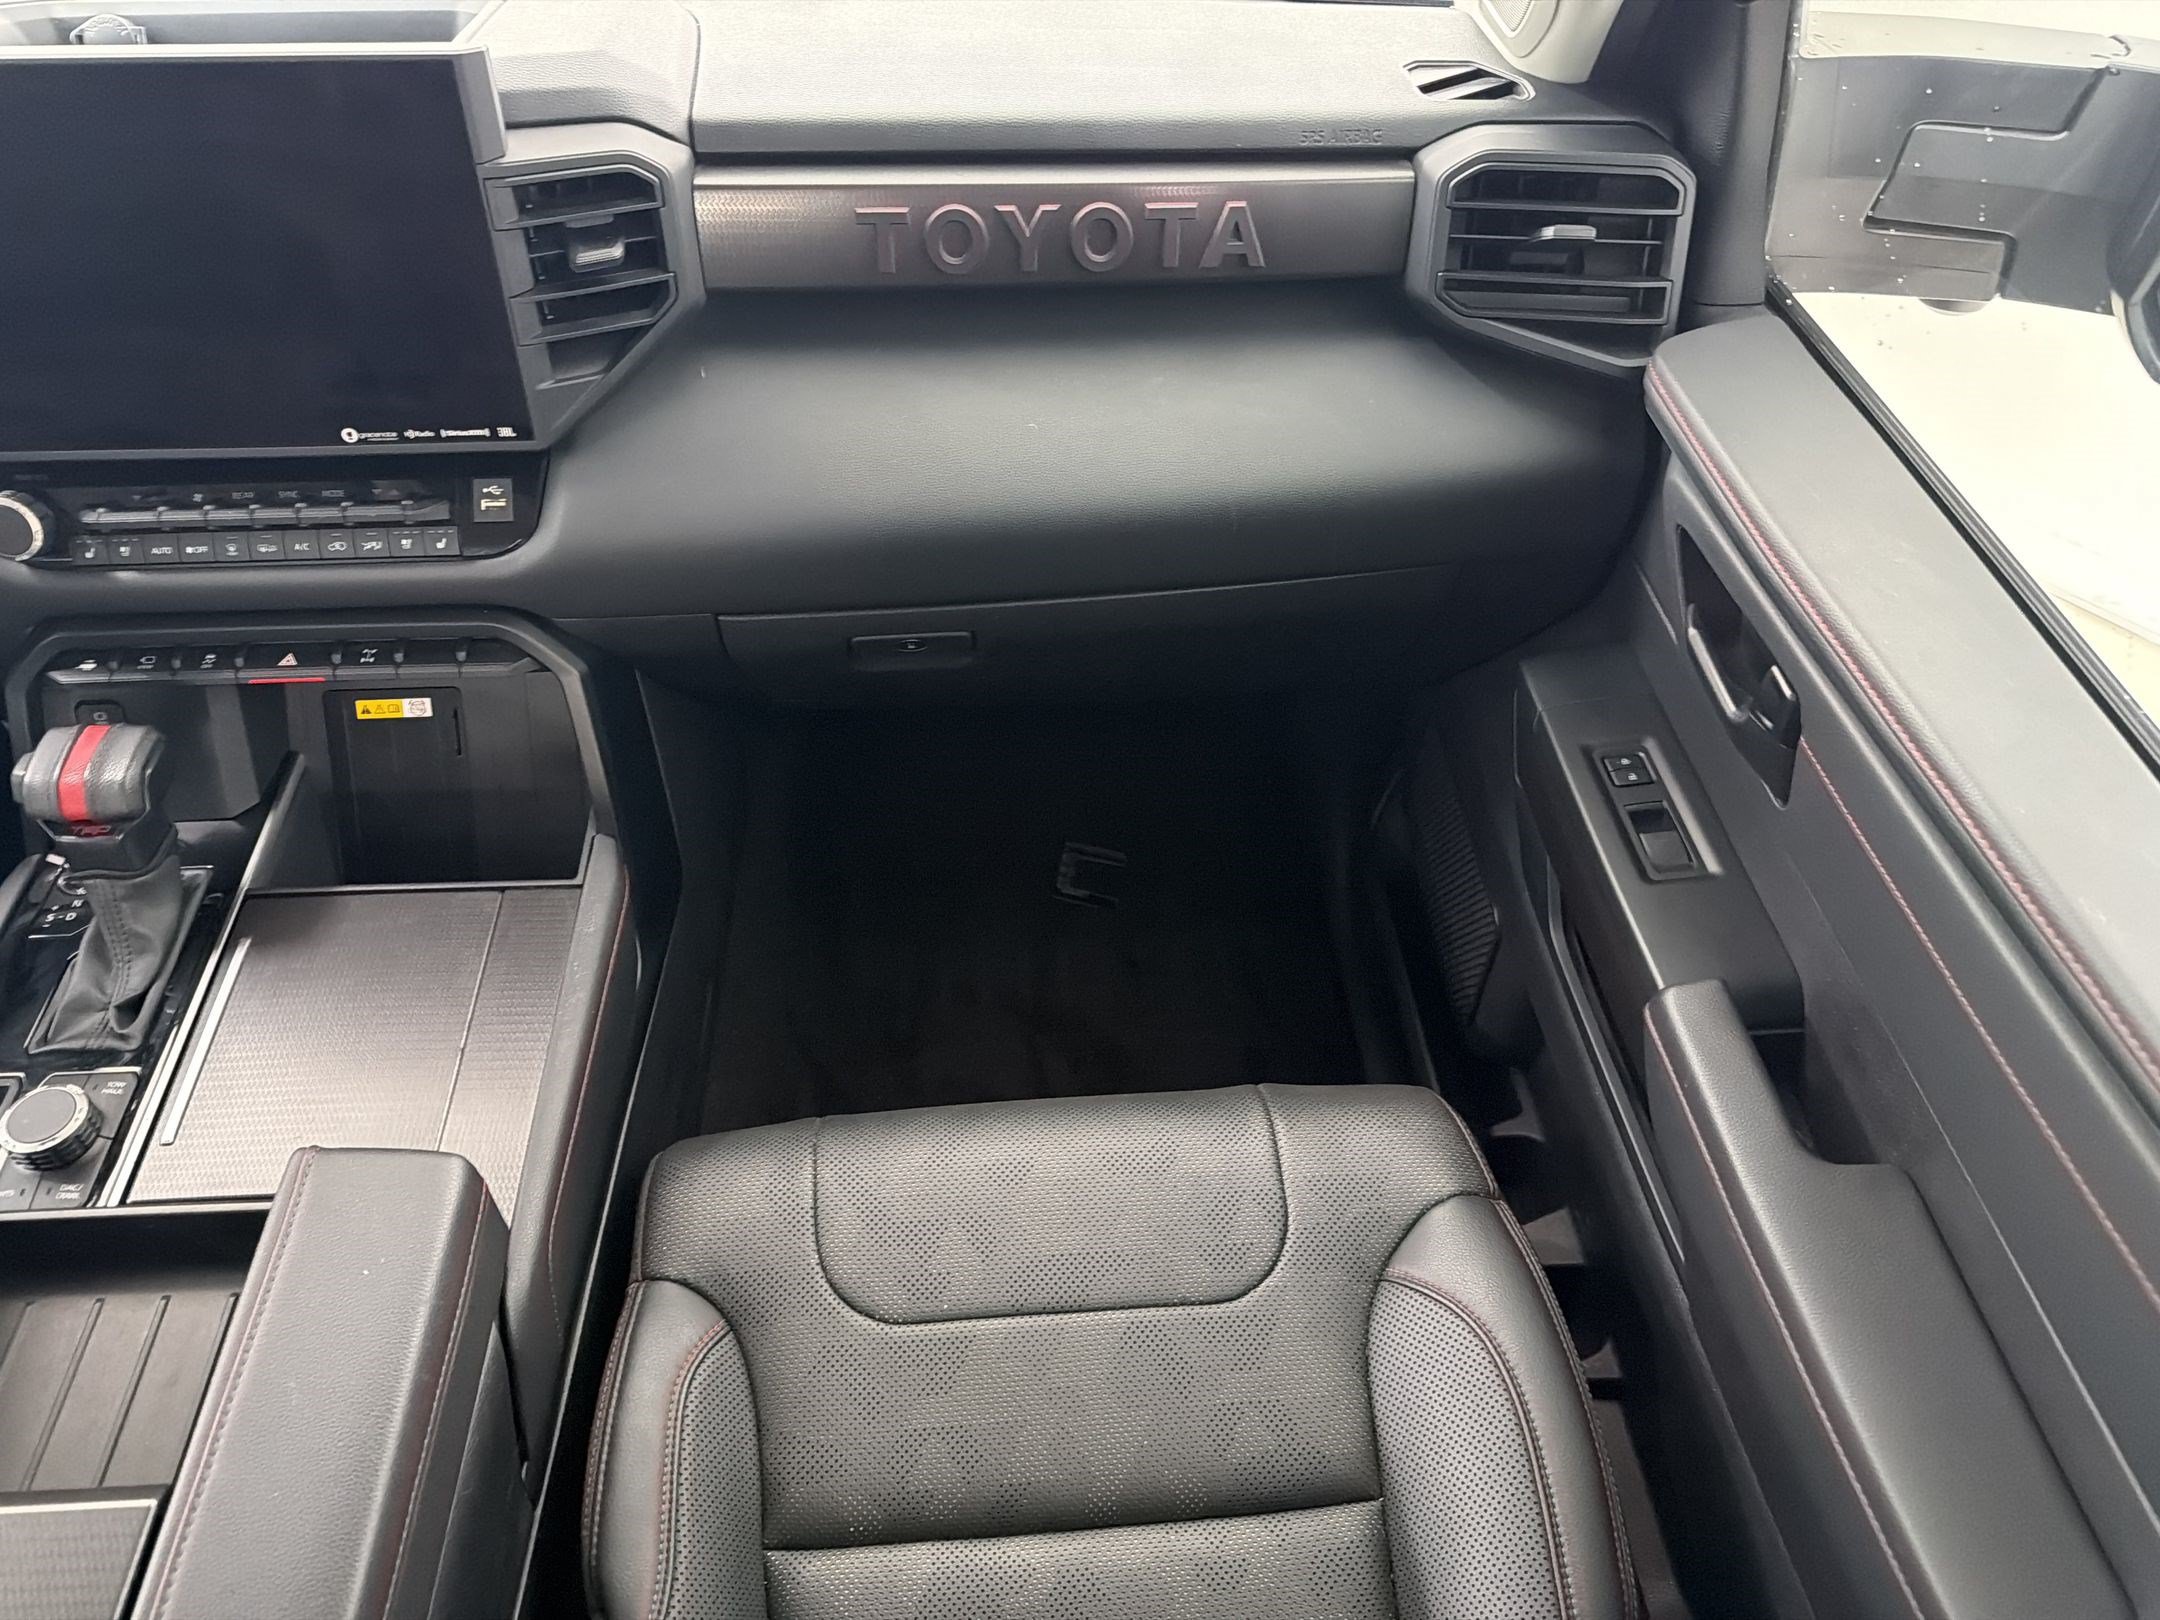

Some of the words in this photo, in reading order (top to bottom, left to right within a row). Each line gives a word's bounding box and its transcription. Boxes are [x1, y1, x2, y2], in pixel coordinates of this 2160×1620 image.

[854, 201, 1266, 274] TOYOTA
[151, 546, 173, 555] AUTO
[294, 543, 310, 551] A/C
